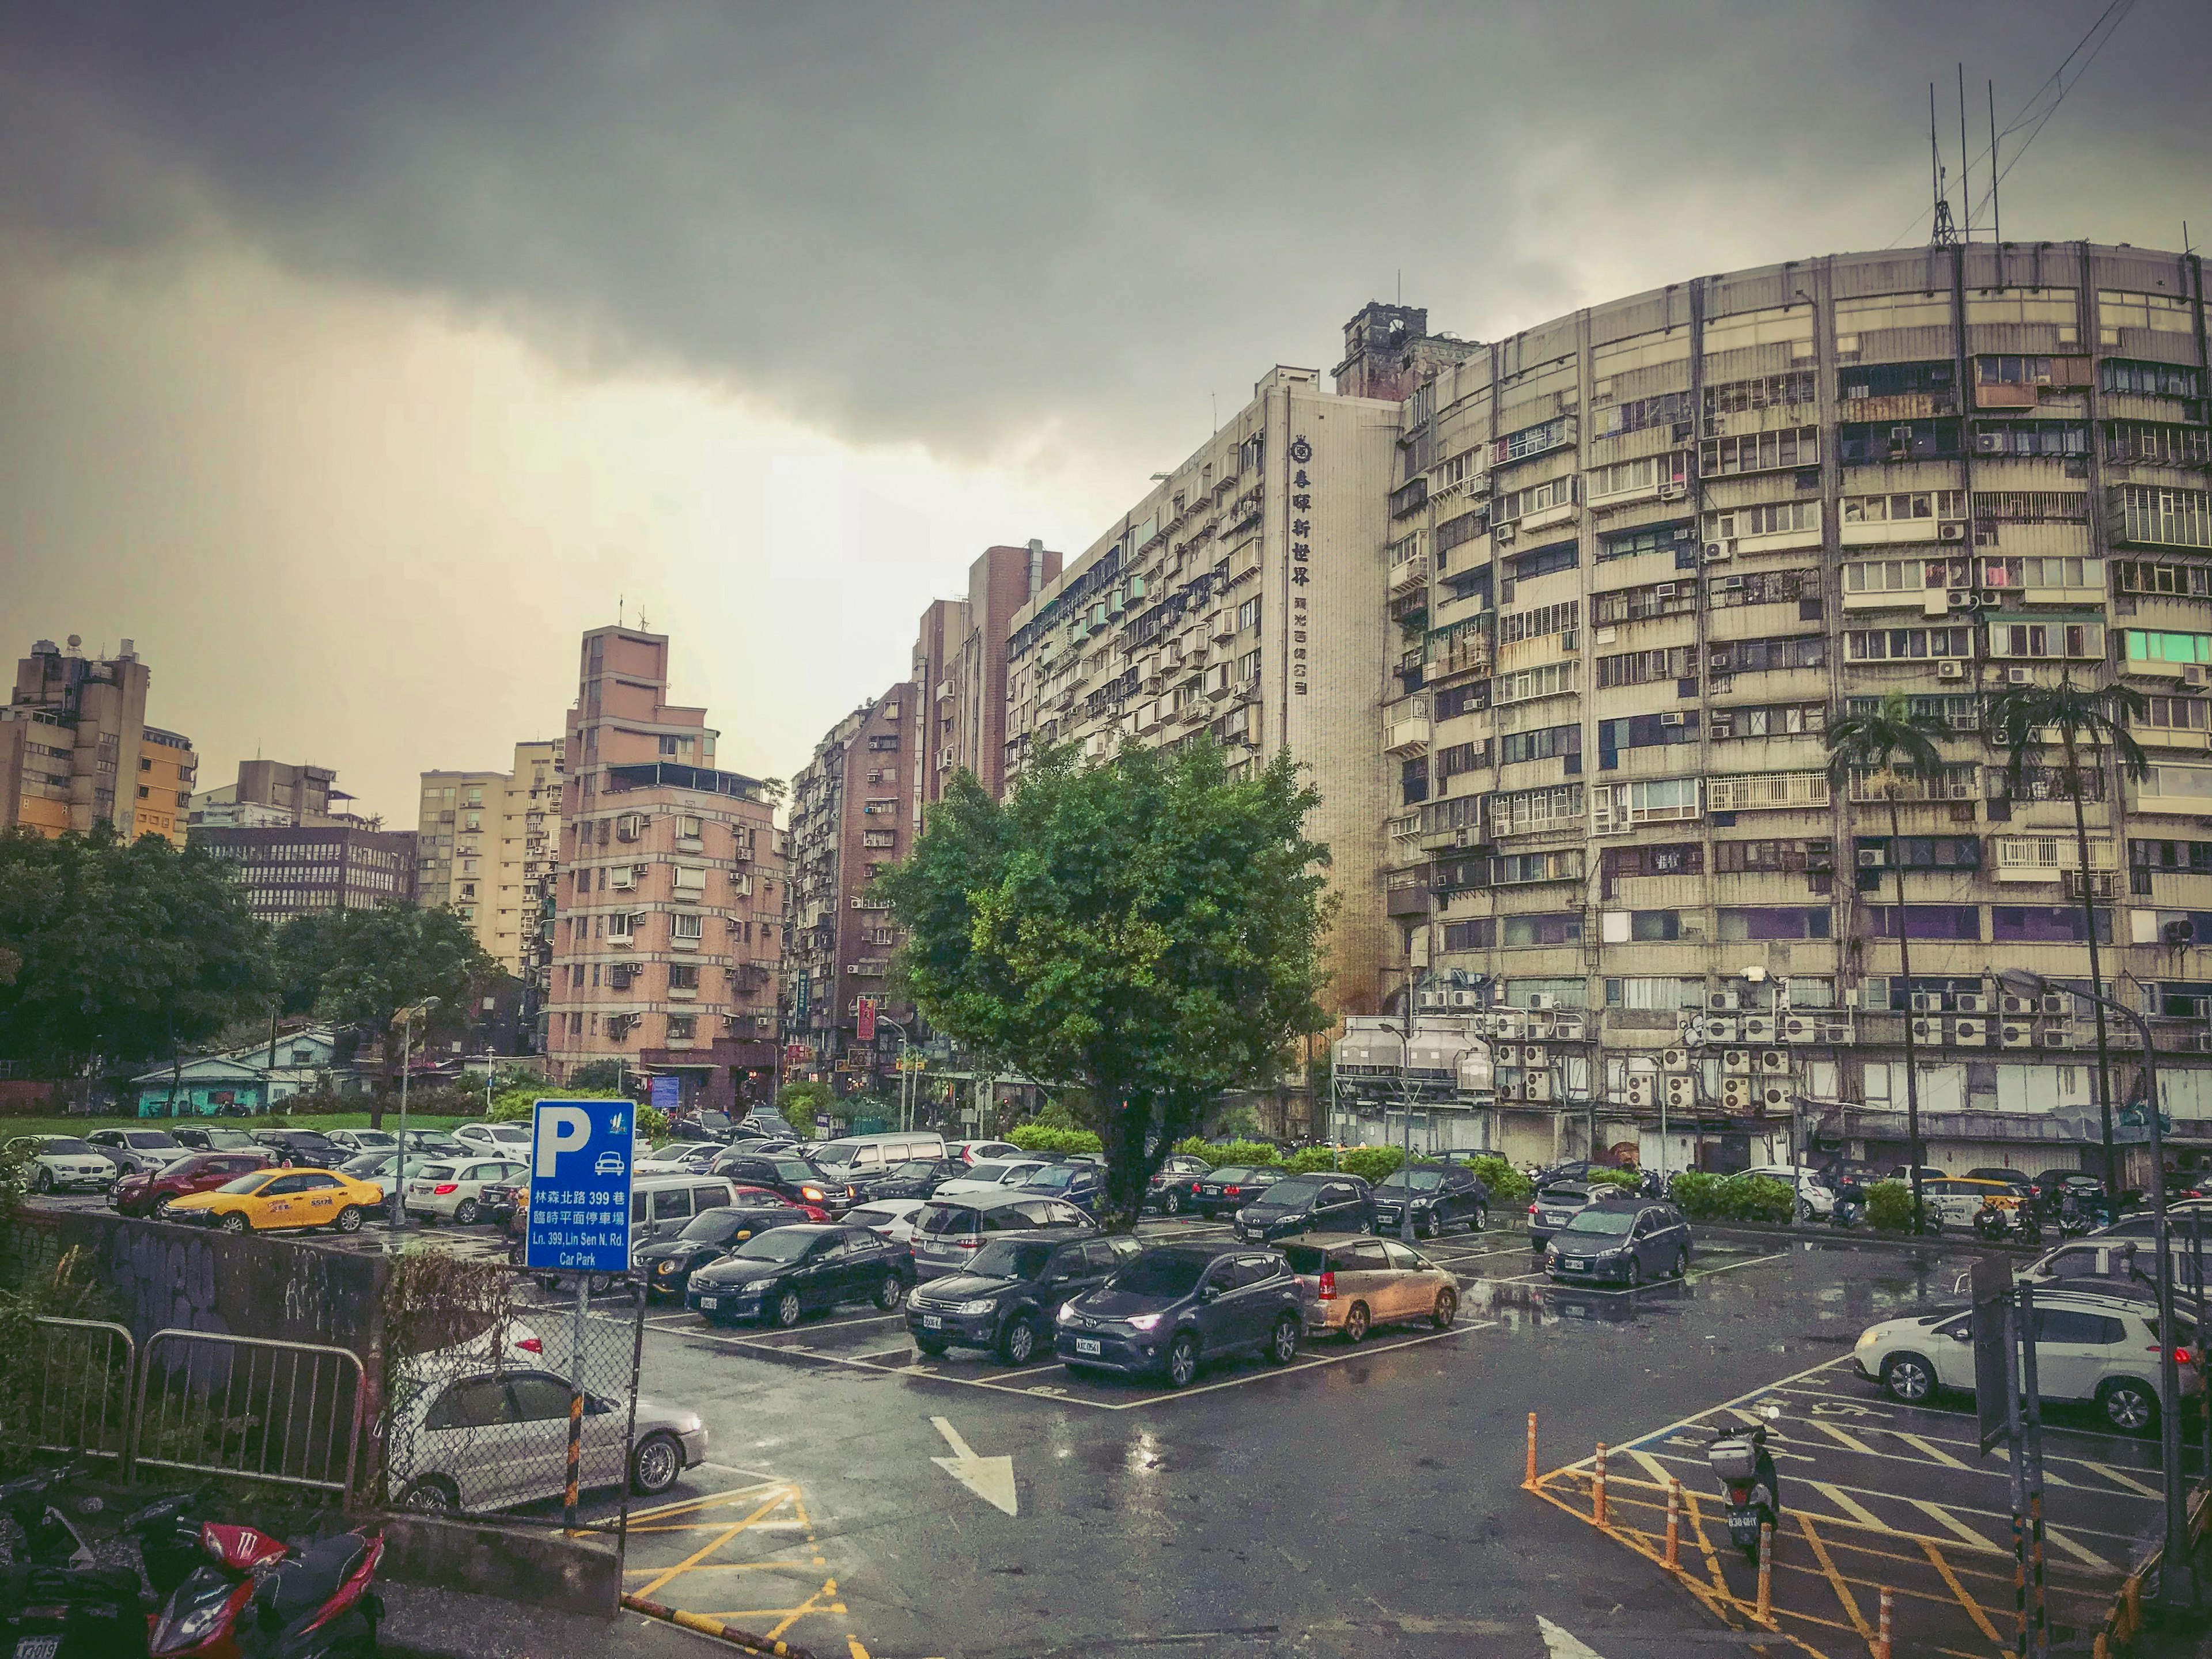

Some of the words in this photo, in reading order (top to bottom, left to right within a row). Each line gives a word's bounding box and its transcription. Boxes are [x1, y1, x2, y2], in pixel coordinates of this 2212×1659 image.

[1291, 469, 1312, 587] 春暉新世界
[536, 1107, 592, 1177] P
[535, 1190, 585, 1205] 林森北路
[589, 1191, 609, 1205] 399
[613, 1191, 624, 1205] 巷
[533, 1210, 624, 1226] 臨時平面停車場
[533, 1231, 546, 1245] Ln.
[580, 1232, 596, 1246] Sen
[599, 1232, 608, 1246] N.
[610, 1233, 624, 1247] Rd.
[559, 1252, 574, 1266] Car
[576, 1252, 595, 1266] Park
